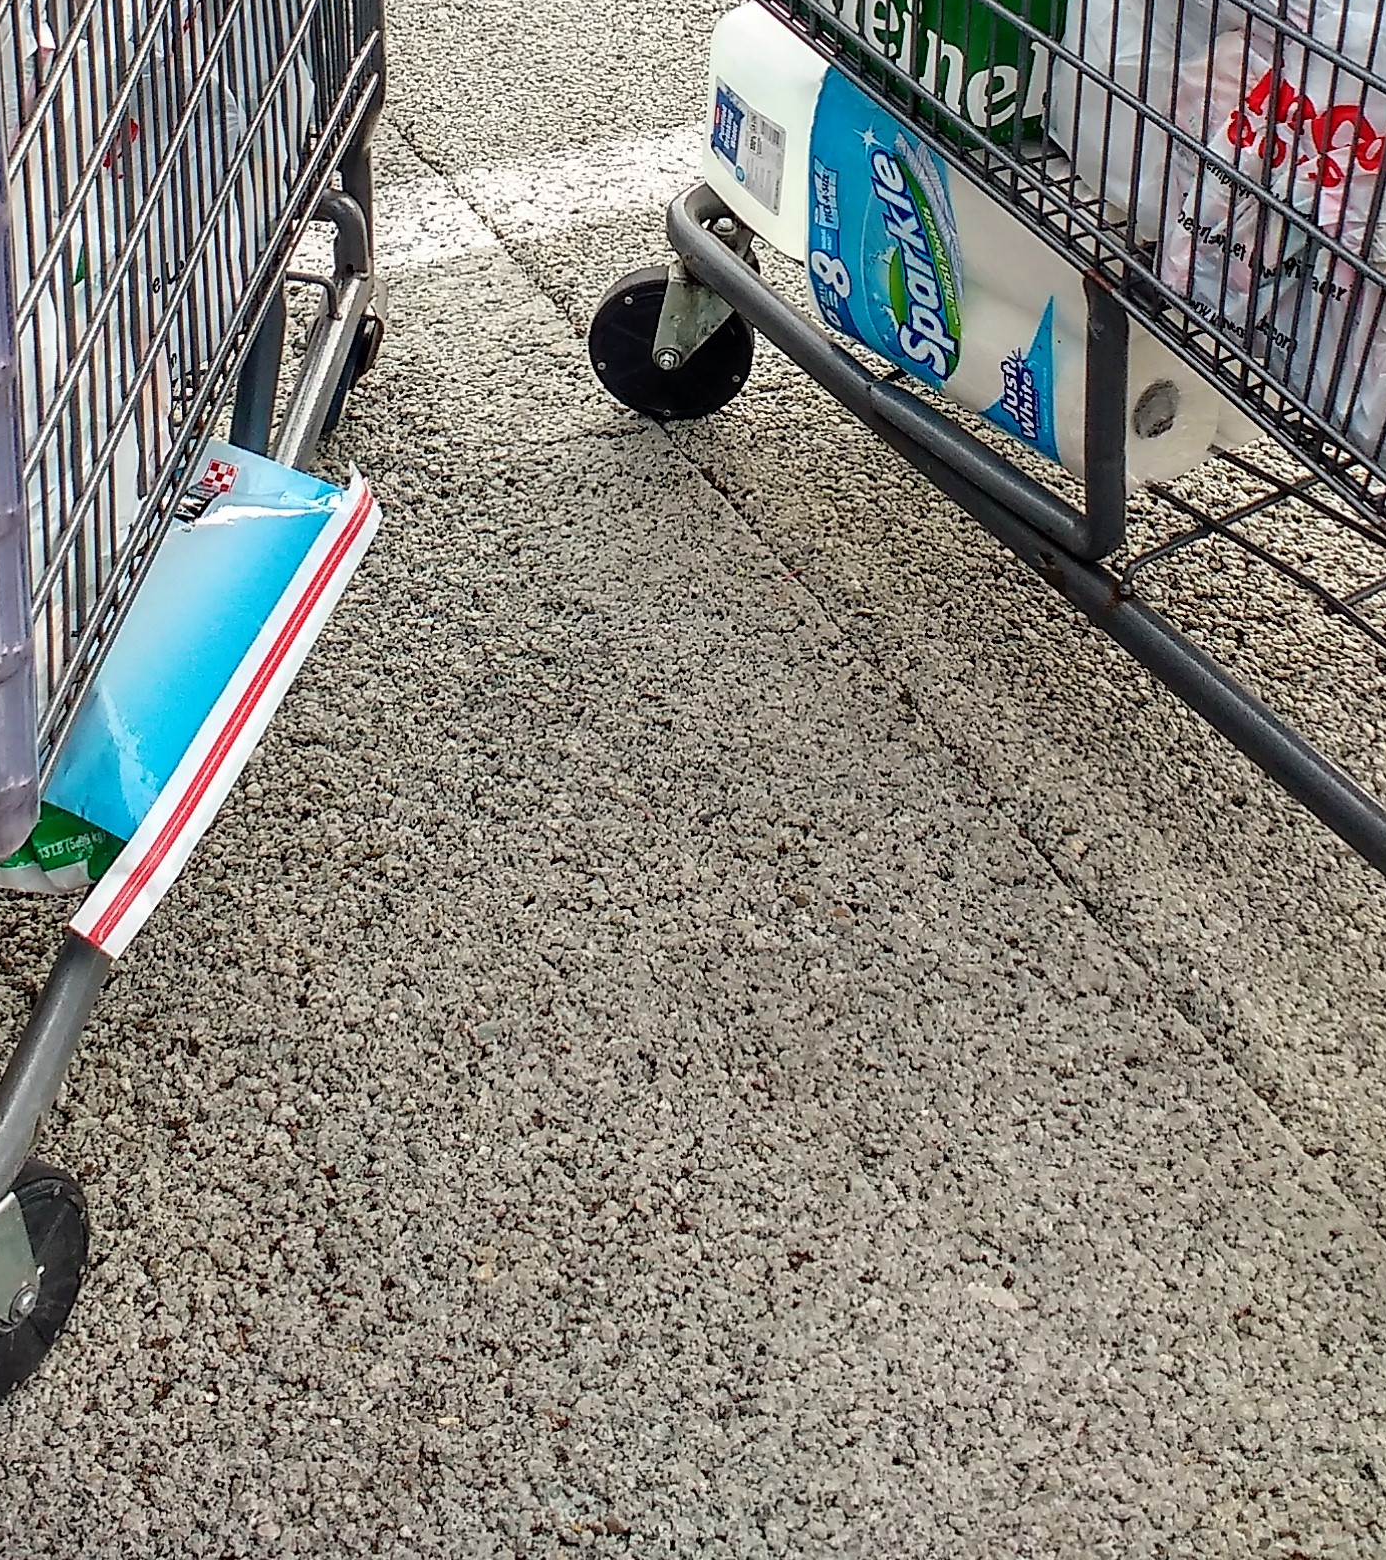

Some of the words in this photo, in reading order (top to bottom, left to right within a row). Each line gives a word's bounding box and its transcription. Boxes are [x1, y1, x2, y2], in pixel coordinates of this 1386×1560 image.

[922, 206, 947, 261] Pockets
[810, 250, 852, 297] 8
[873, 149, 958, 380] Sparkle
[939, 264, 957, 303] Thirst
[1001, 357, 1020, 422] Just
[1019, 370, 1038, 440] White
[51, 841, 64, 857] LB
